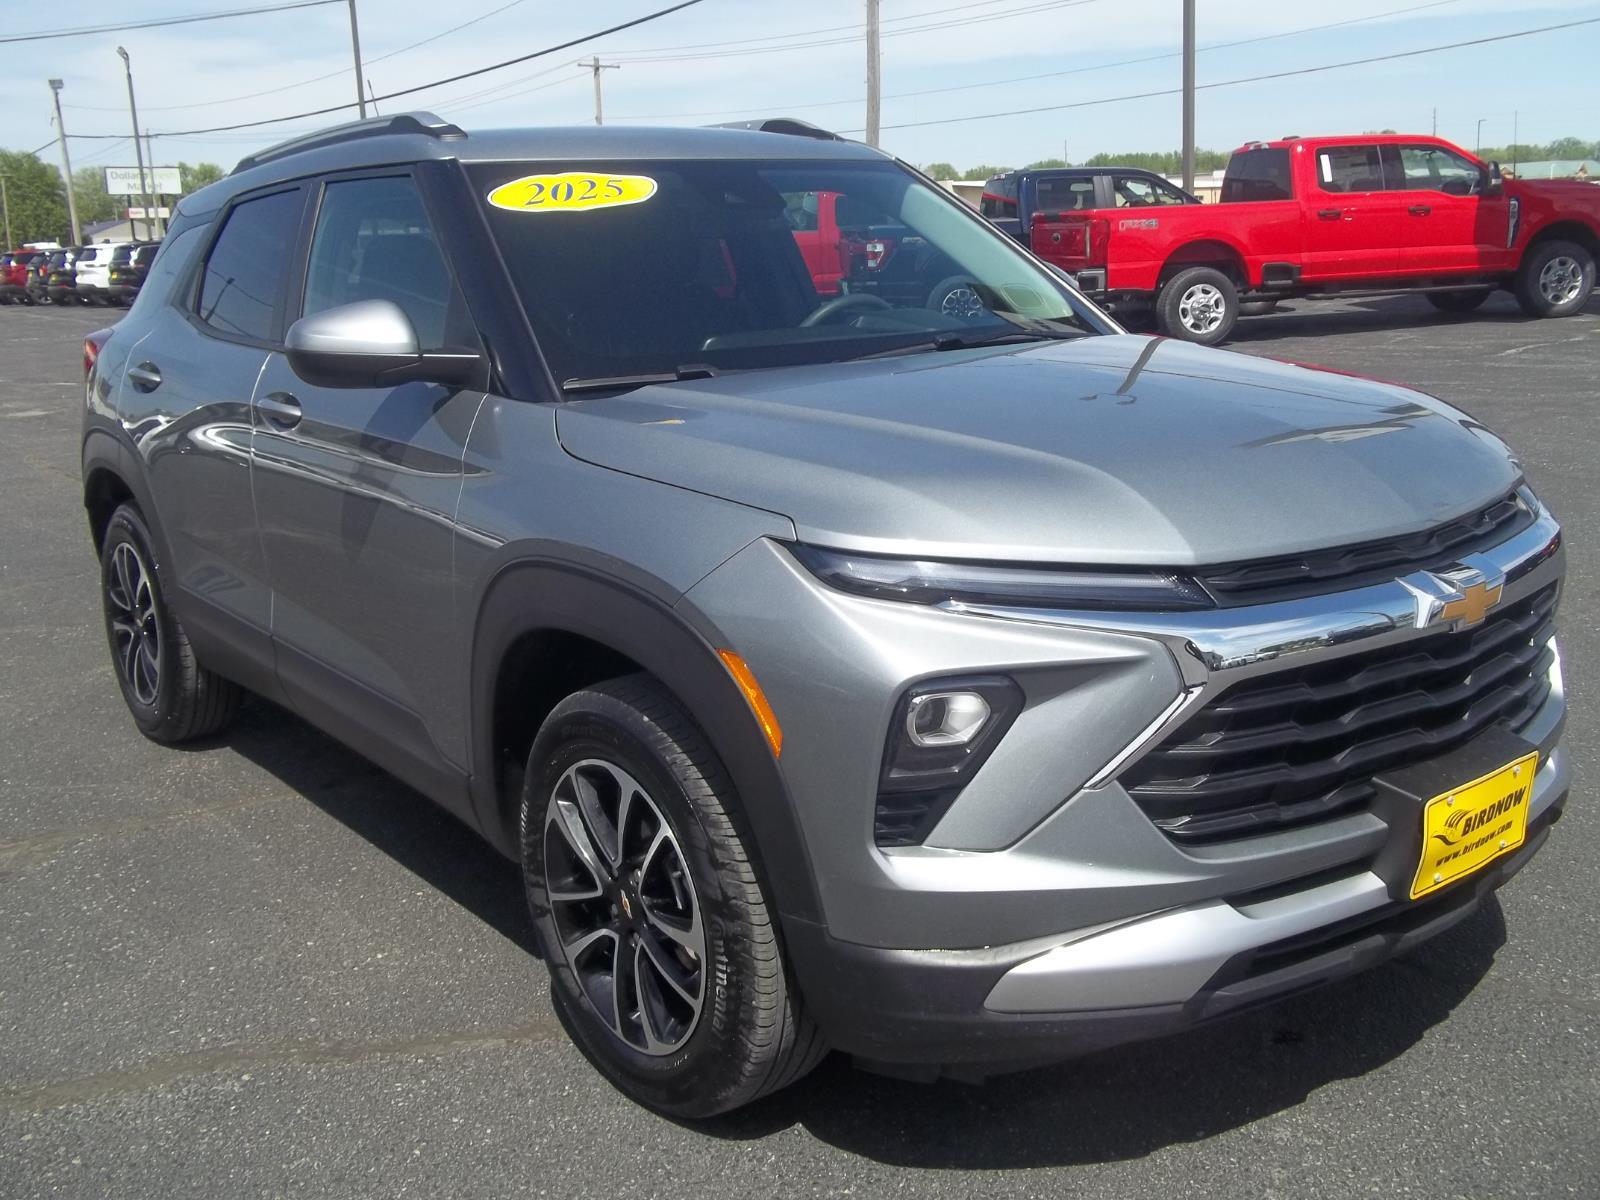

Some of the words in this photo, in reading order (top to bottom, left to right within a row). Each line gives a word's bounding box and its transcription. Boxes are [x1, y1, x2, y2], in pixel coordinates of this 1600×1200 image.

[525, 179, 624, 206] 2025
[1461, 786, 1528, 837] BIRDNOW
[1435, 820, 1513, 867] www.birdnow.com
